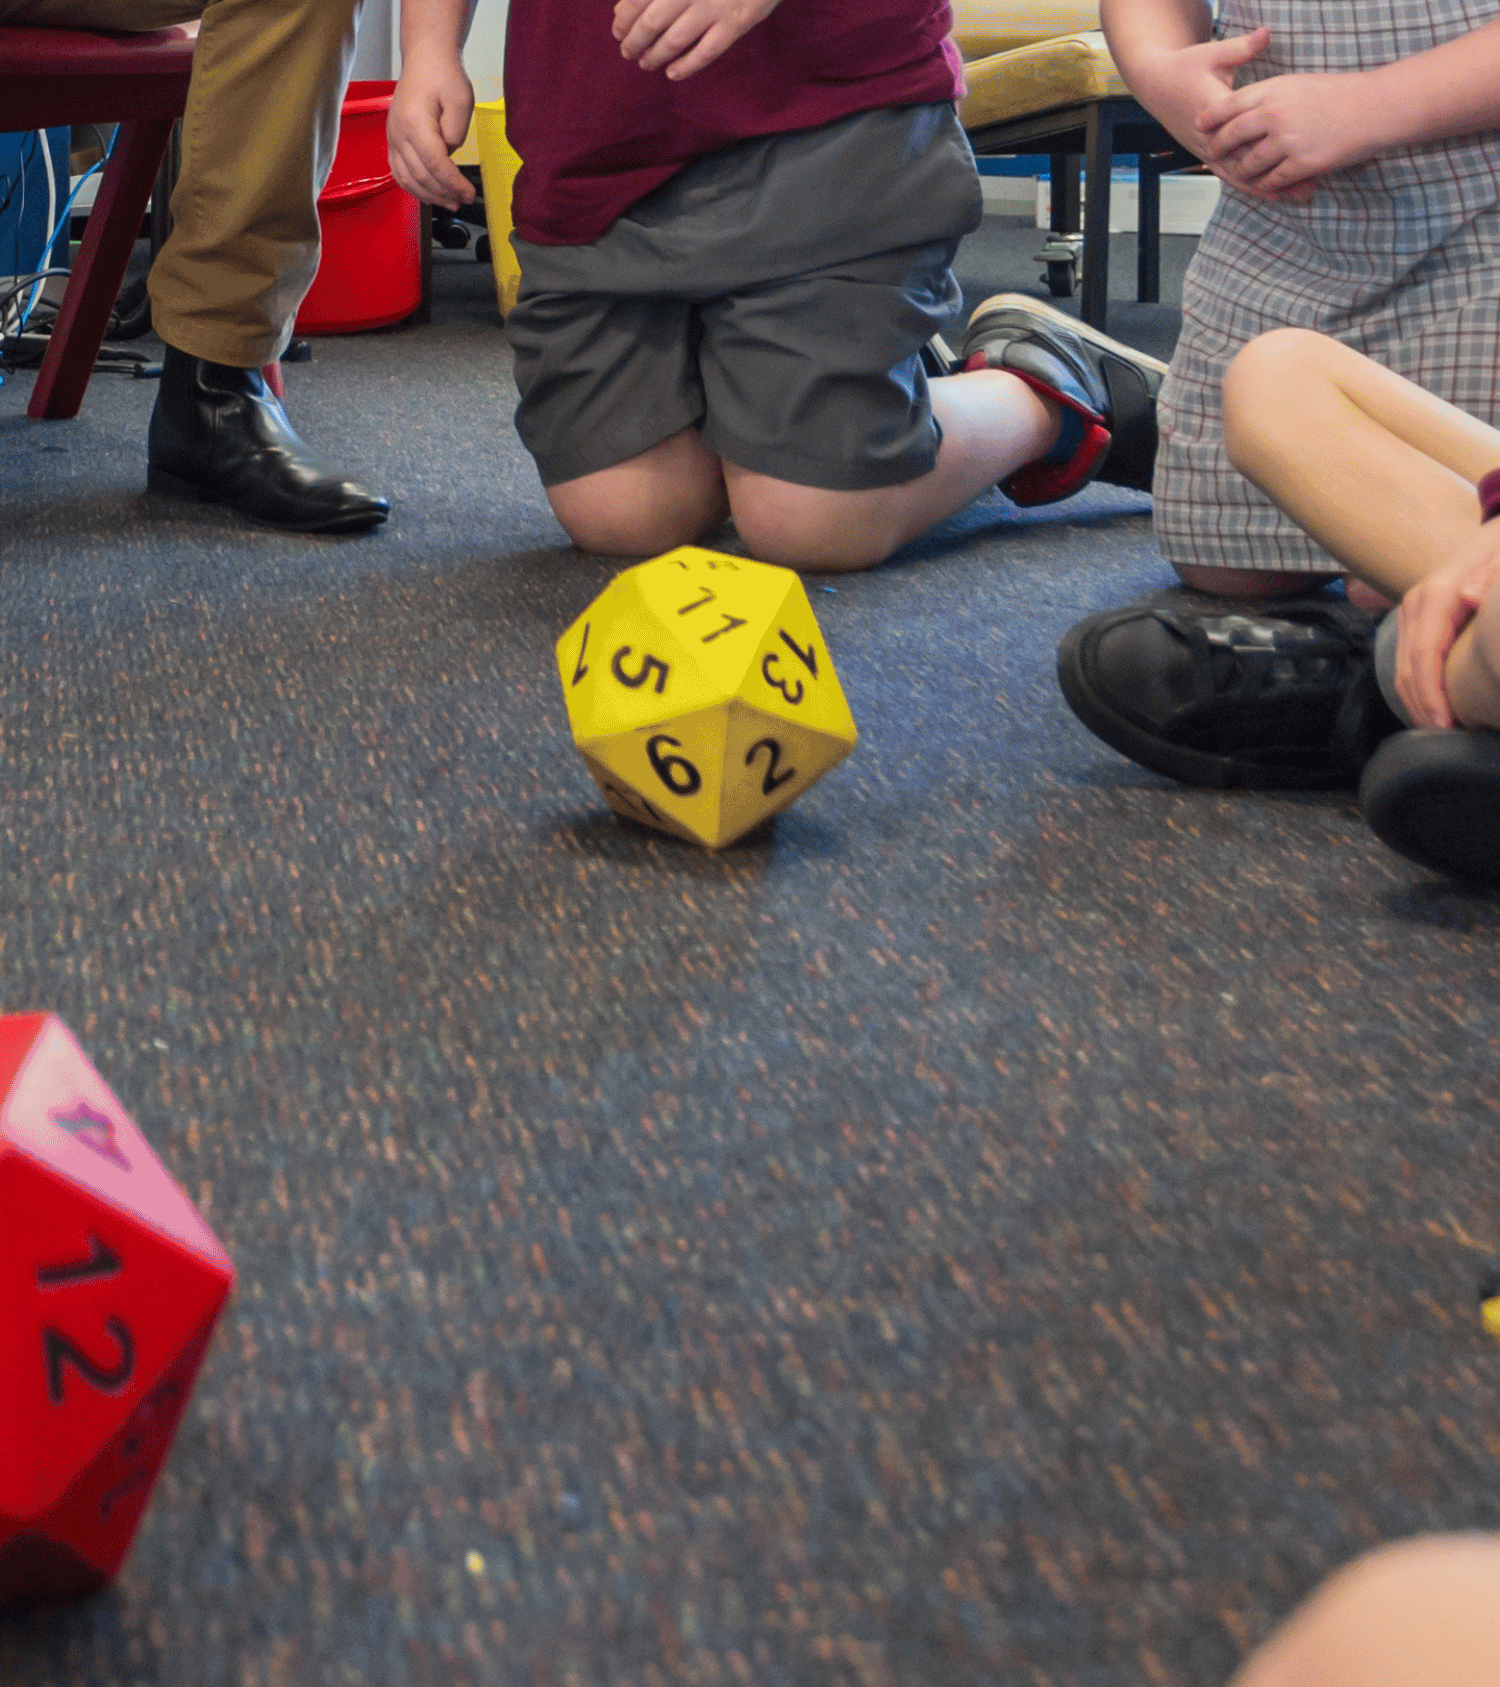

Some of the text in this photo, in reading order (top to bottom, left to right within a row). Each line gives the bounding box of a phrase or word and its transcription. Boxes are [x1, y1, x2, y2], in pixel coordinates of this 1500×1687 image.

[610, 644, 671, 695] 5
[761, 628, 820, 704] 13
[744, 736, 797, 796] 2
[47, 1101, 133, 1174] 4
[35, 1234, 136, 1404] 12
